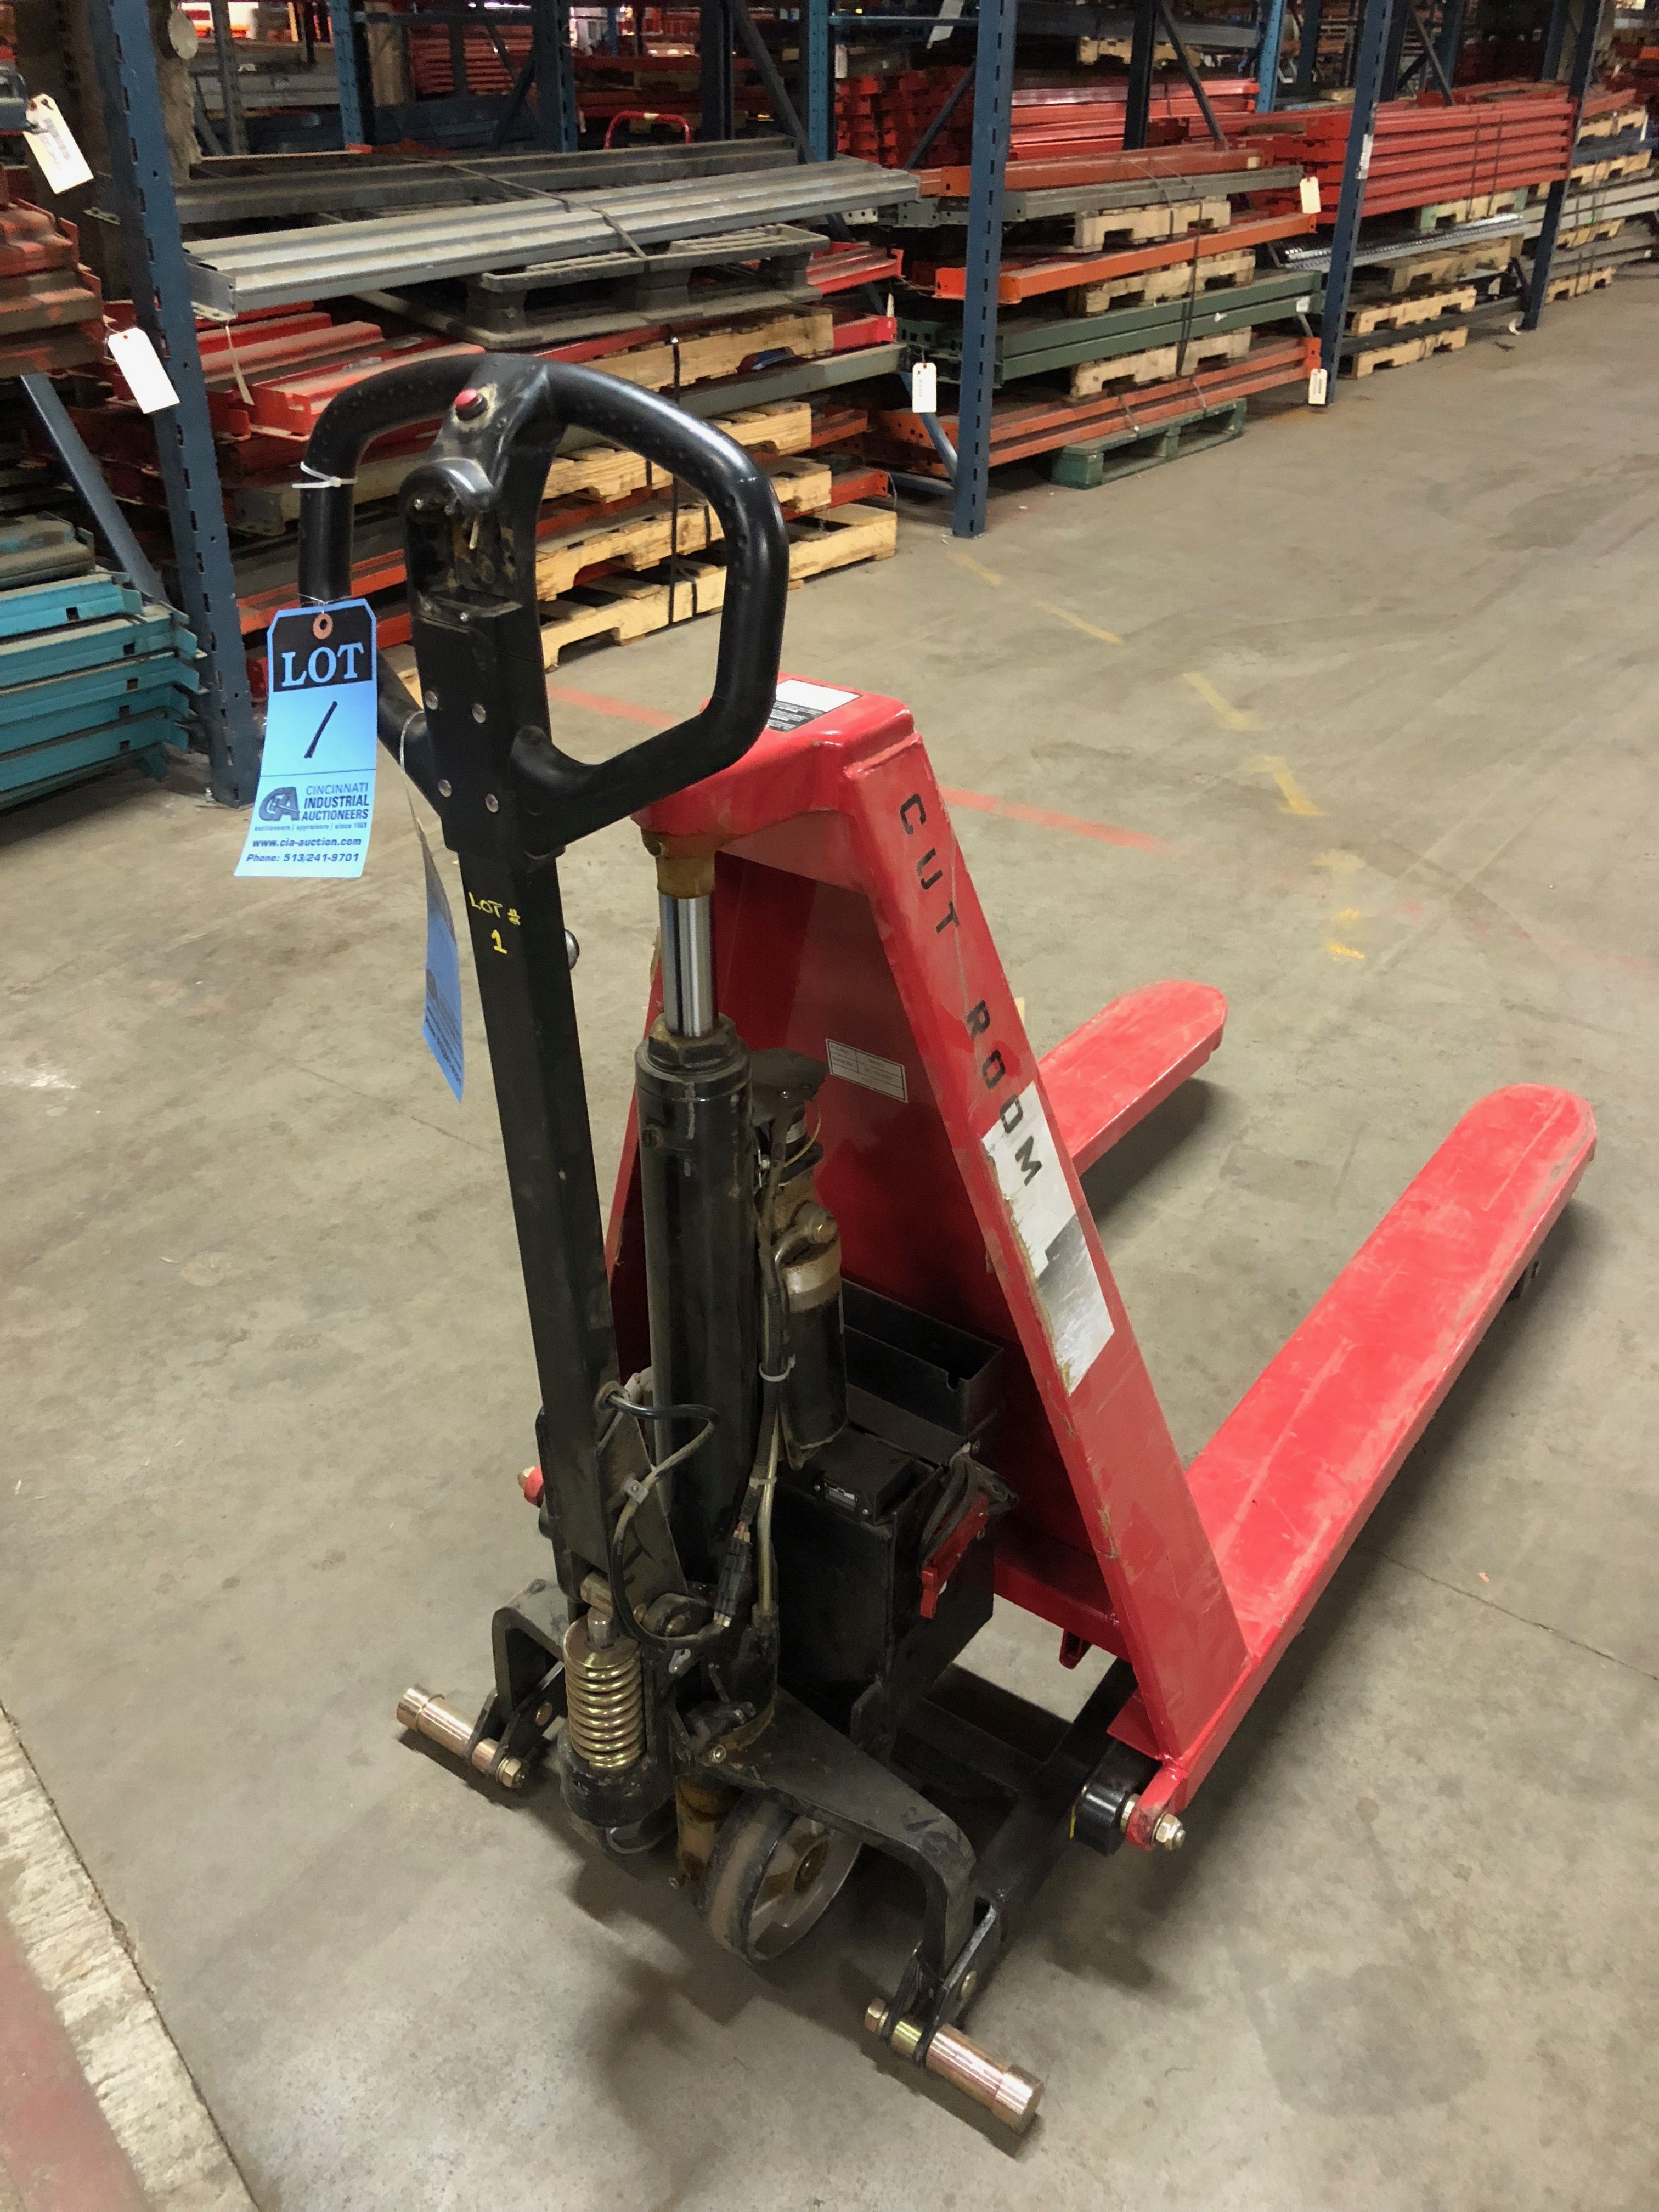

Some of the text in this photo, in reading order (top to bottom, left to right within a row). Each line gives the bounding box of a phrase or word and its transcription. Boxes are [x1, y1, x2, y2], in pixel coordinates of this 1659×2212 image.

[281, 642, 364, 687] LOT
[306, 782, 369, 795] CINCINNATI
[303, 795, 369, 809] INDUSTRIAL
[302, 809, 369, 821] AUCTIONEERS
[252, 838, 361, 847] www.cia-auction.com
[246, 853, 359, 862] Phone: 513/241-9701
[468, 891, 503, 918] LOT
[491, 929, 507, 954] 1
[900, 793, 1042, 1186] CUT ROOM
